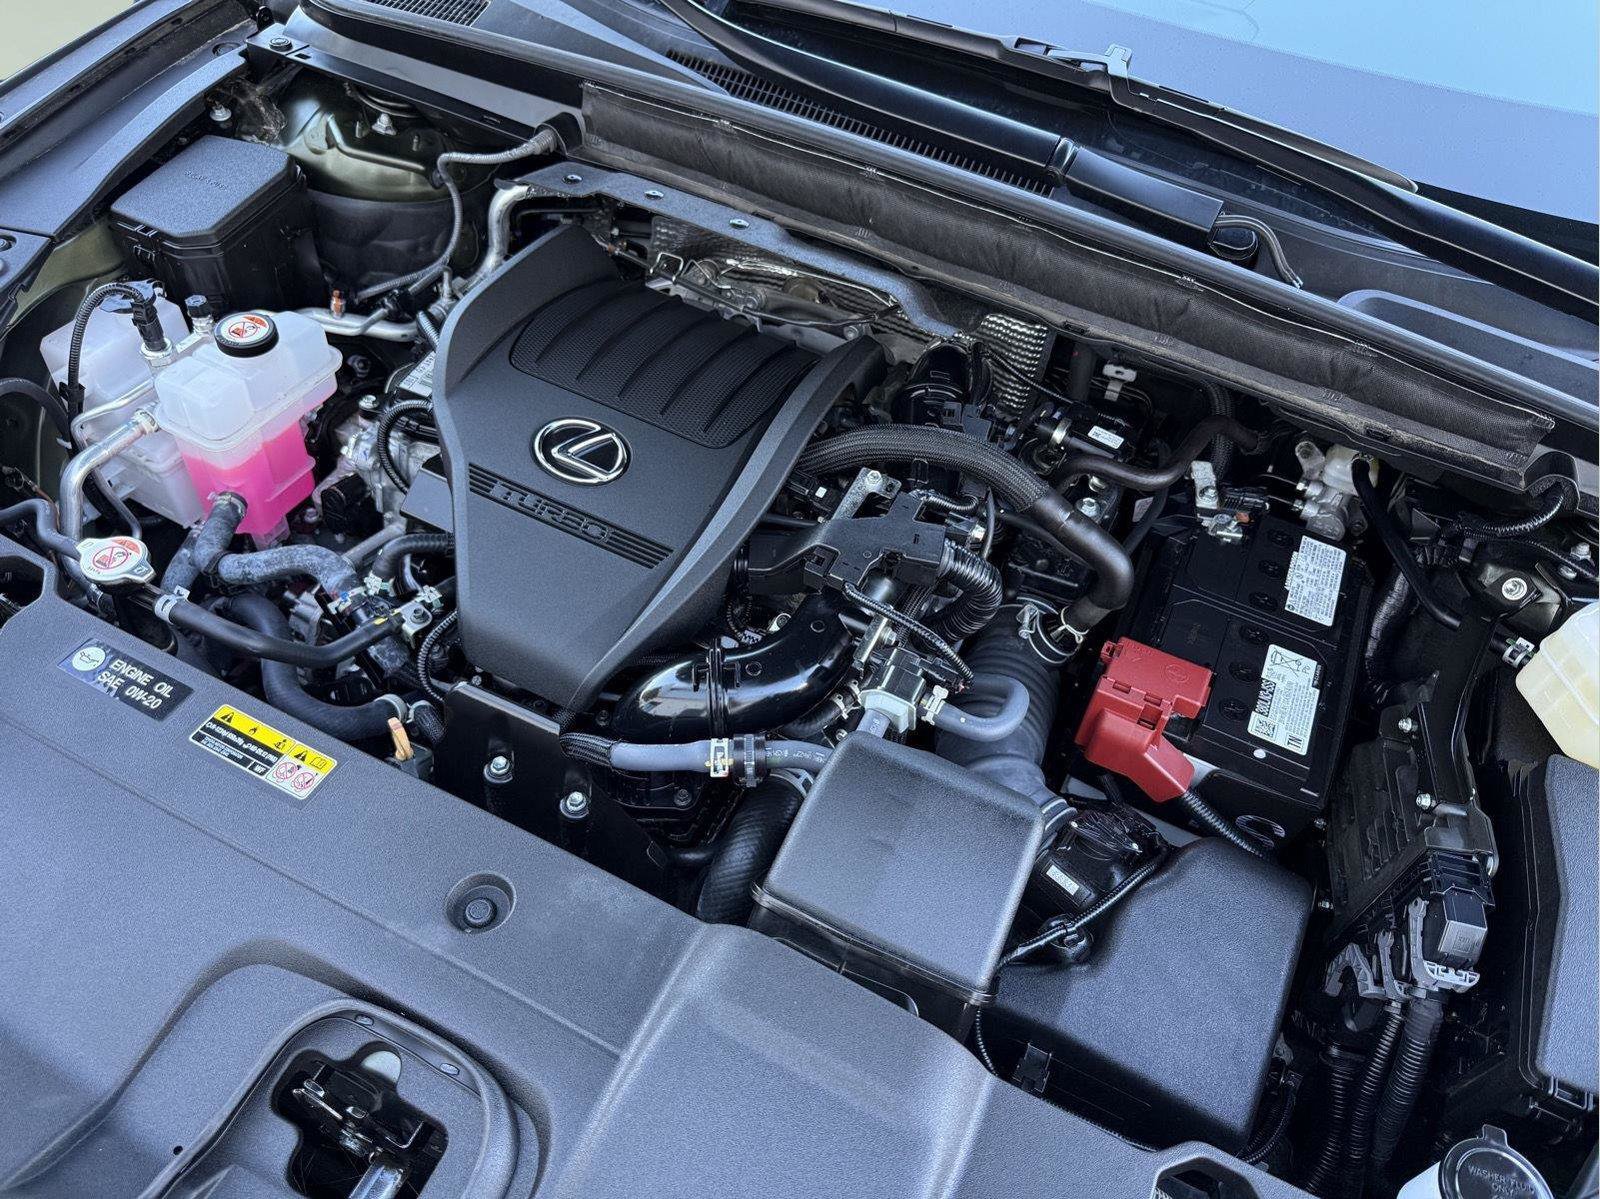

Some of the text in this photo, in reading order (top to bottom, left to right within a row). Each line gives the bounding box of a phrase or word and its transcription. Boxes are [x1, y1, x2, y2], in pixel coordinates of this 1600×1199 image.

[489, 481, 610, 542] TURBO
[97, 671, 162, 709] SAE 0W-20
[110, 659, 174, 698] ENGINE OIL
[1468, 1165, 1507, 1184] WASHER
[1491, 1182, 1515, 1196] ONLY
